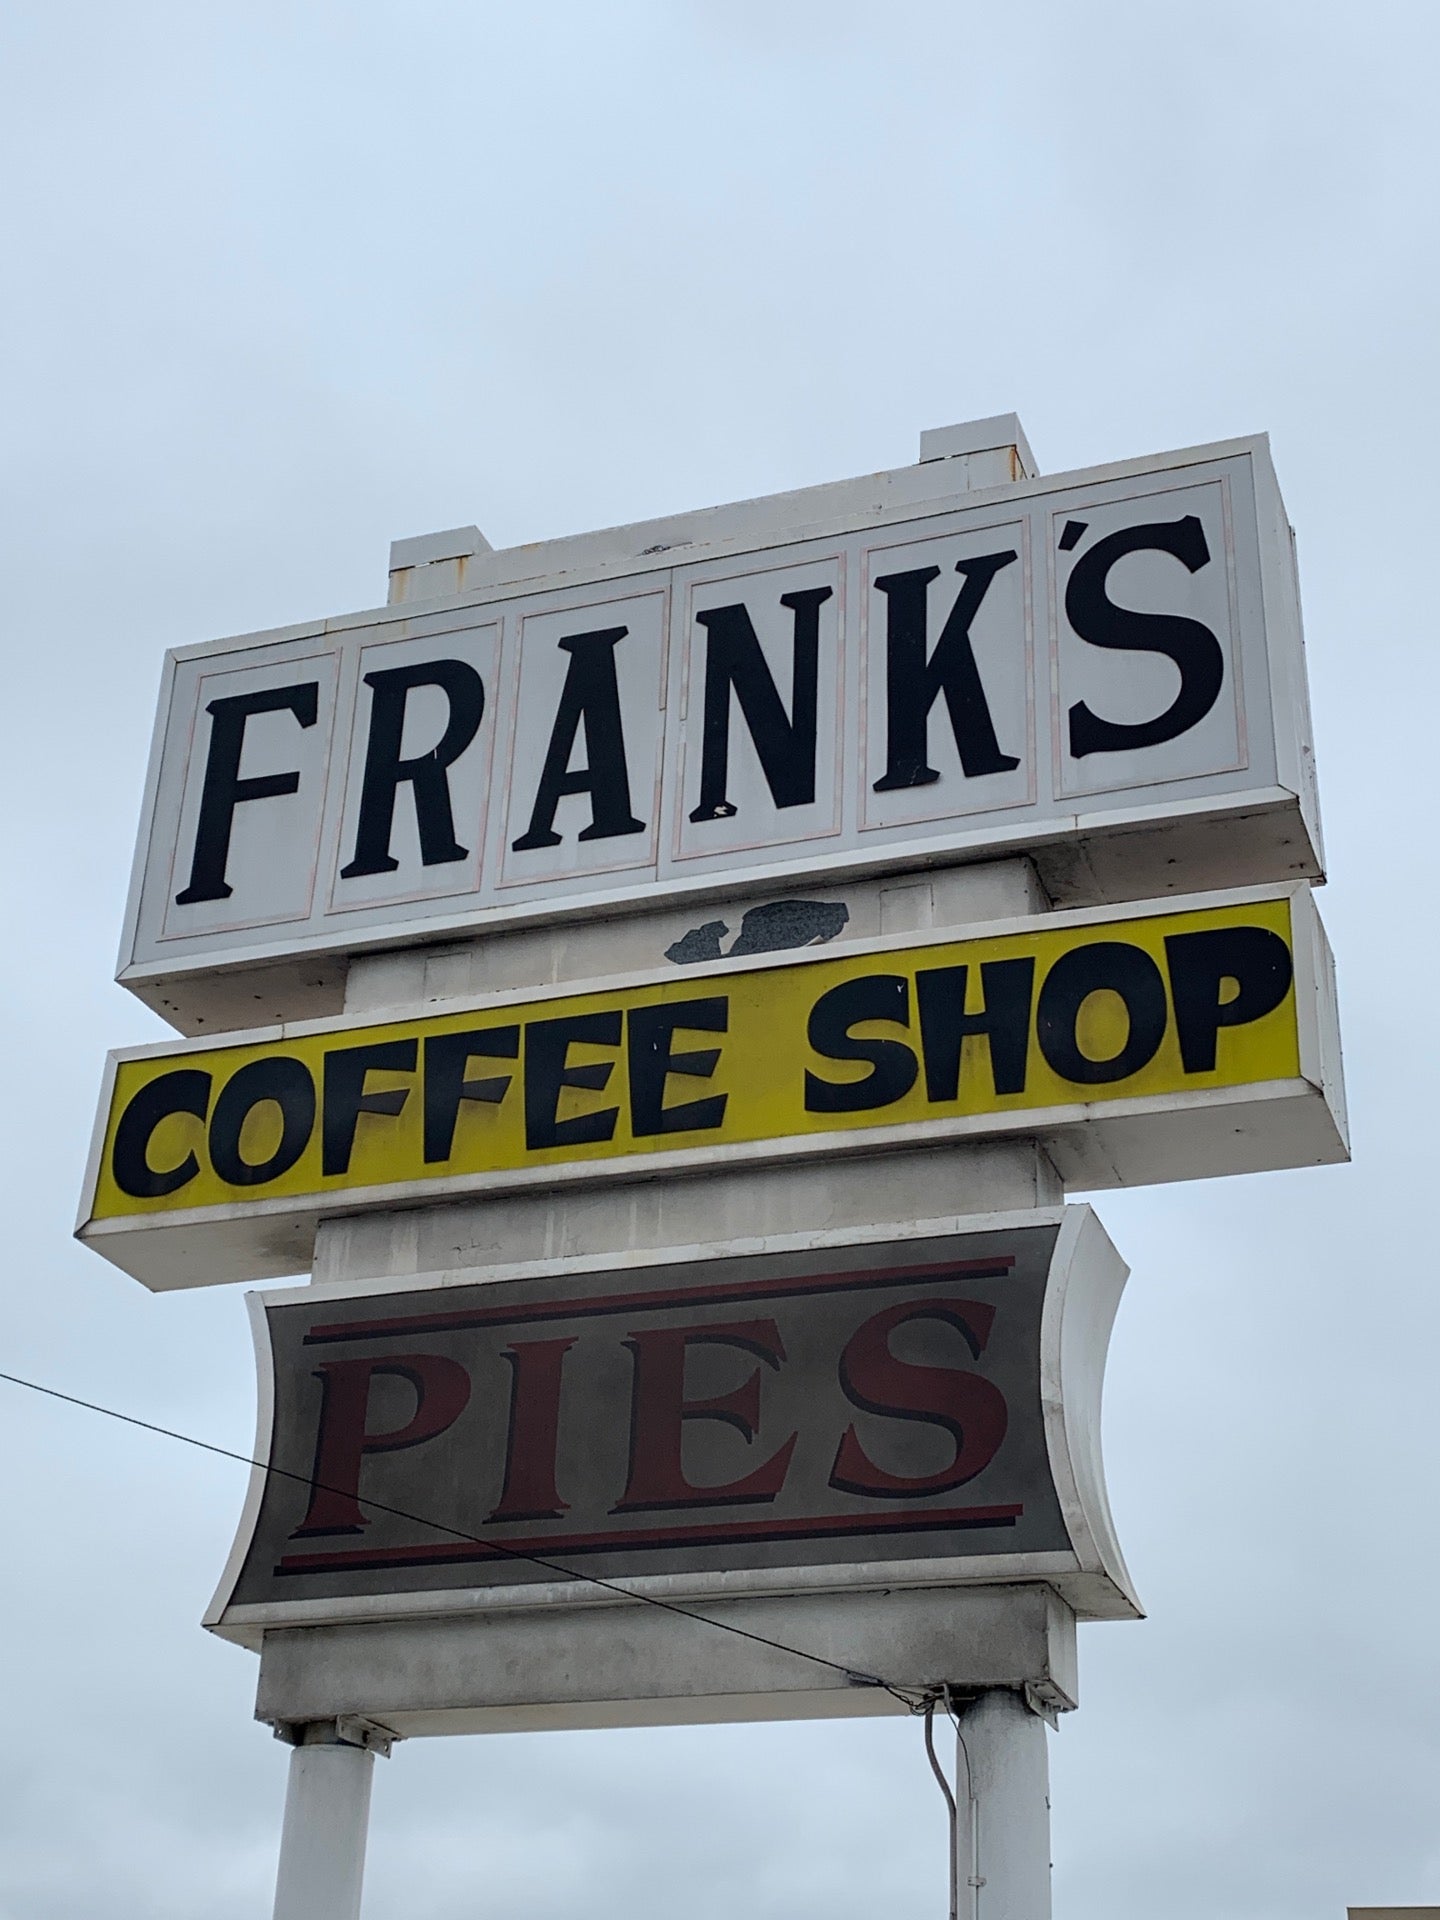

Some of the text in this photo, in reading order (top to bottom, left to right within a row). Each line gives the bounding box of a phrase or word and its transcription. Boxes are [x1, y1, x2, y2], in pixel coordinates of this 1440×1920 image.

[176, 515, 1224, 905] FRANK'S
[112, 926, 1293, 1197] COFFEE SHOP
[288, 1298, 1008, 1540] PIES
